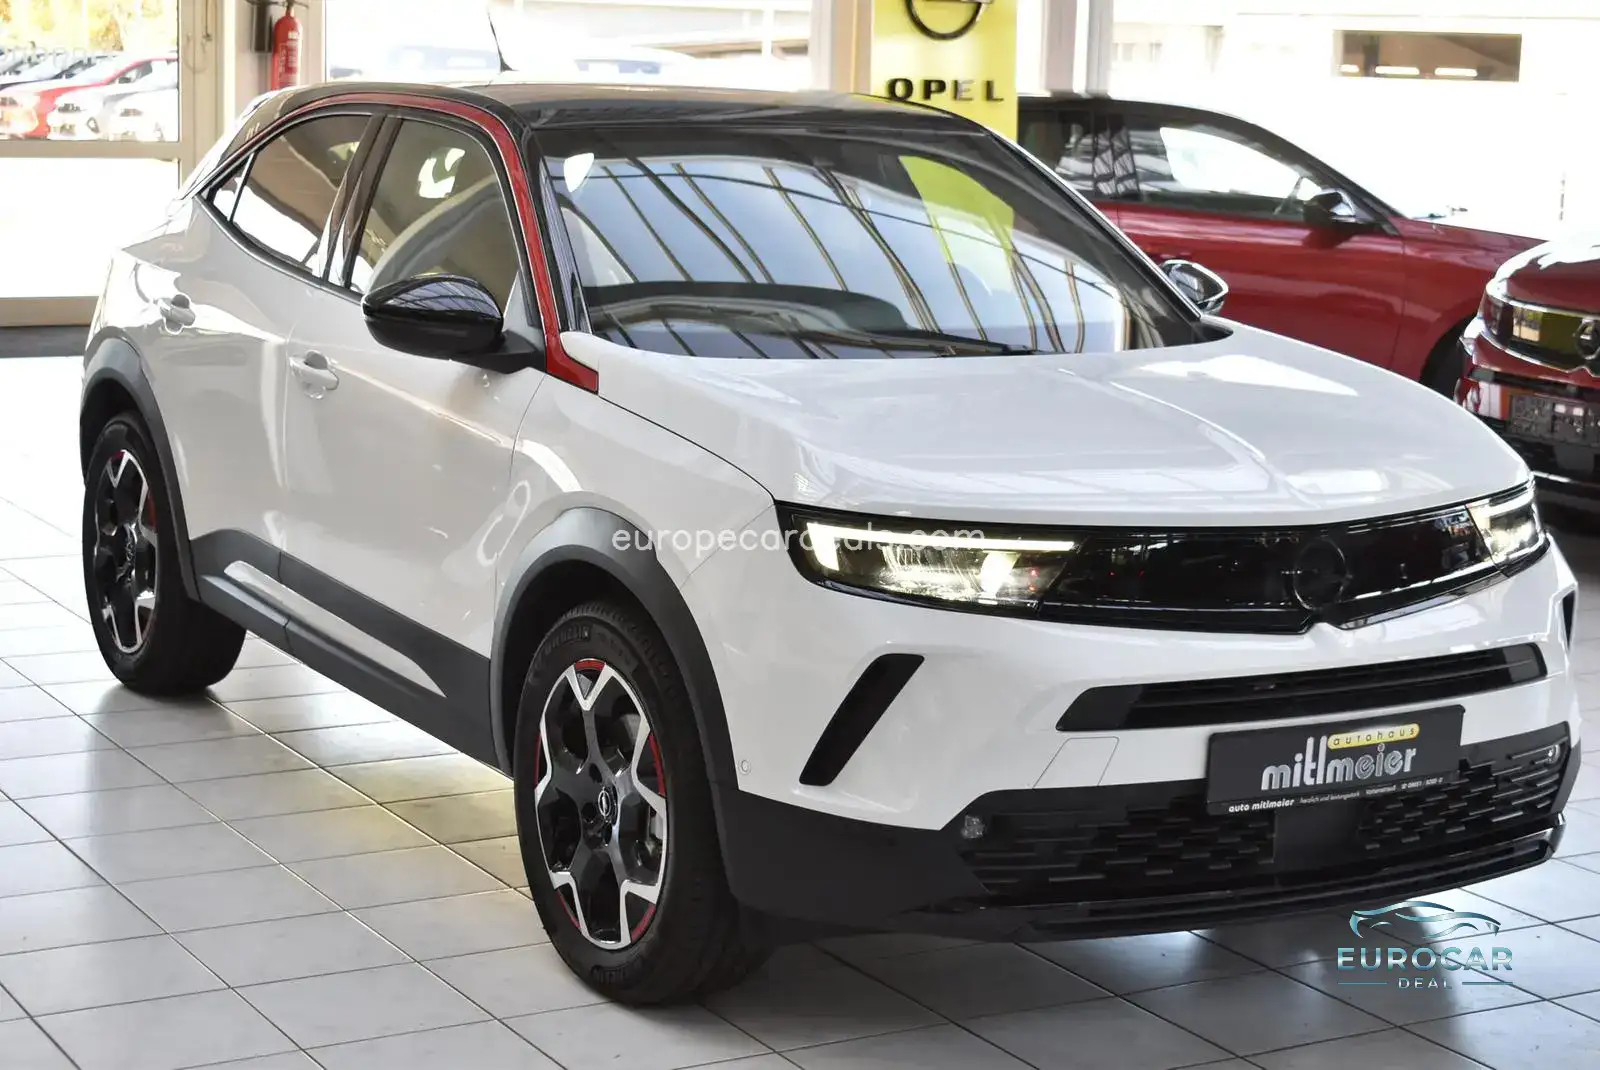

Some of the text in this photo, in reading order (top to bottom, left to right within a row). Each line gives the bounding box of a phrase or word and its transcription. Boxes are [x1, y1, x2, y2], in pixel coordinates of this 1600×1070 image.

[887, 77, 1004, 102] OPEL
[1332, 727, 1416, 747] autohaus
[1260, 734, 1417, 791] mitlmeier
[1228, 798, 1295, 813] auto mitlmeier
